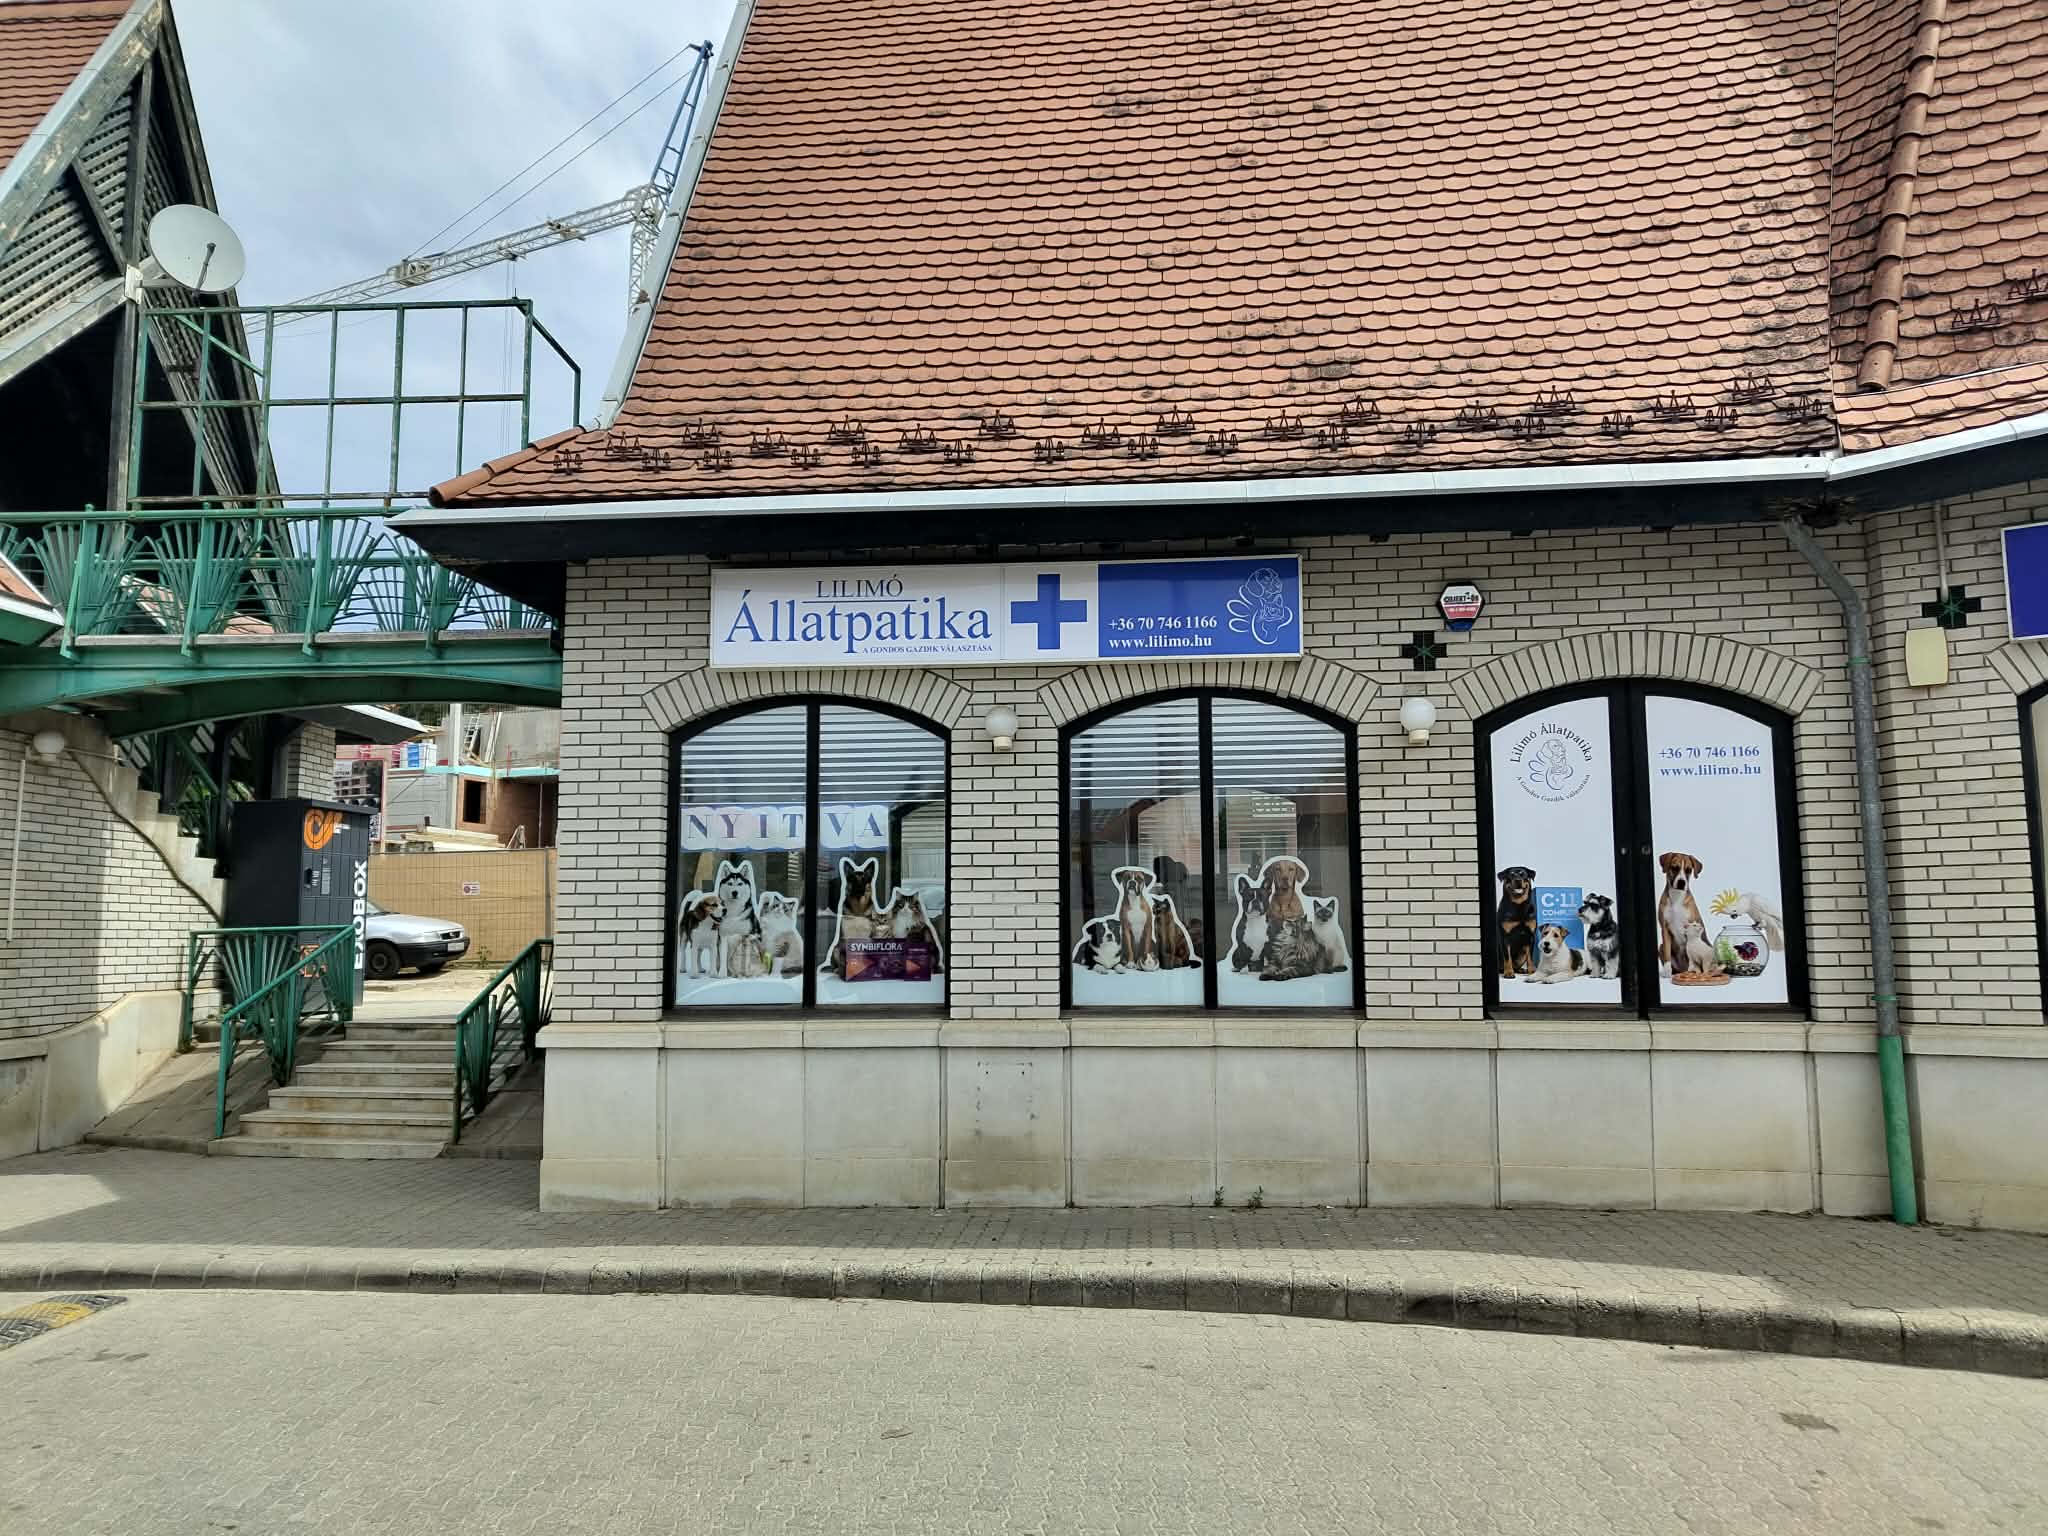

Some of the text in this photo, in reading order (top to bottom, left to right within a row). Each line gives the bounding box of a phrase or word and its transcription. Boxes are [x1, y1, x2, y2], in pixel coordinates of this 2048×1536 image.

[816, 574, 903, 598] LILIMÓ
[722, 589, 993, 654] Állatpatika
[1108, 615, 1218, 631] +36 70 746 1166
[870, 646, 905, 654] GONDOS
[906, 645, 939, 653] GAZDIK
[940, 644, 993, 652] VÁLASZTÁSA
[1108, 634, 1213, 649] www.lilimo.hu
[1510, 723, 1593, 763] Lilimó Állatpatika
[1659, 746, 1760, 759] +36 70 746 1166
[1660, 764, 1761, 776] www.lilimo.hu
